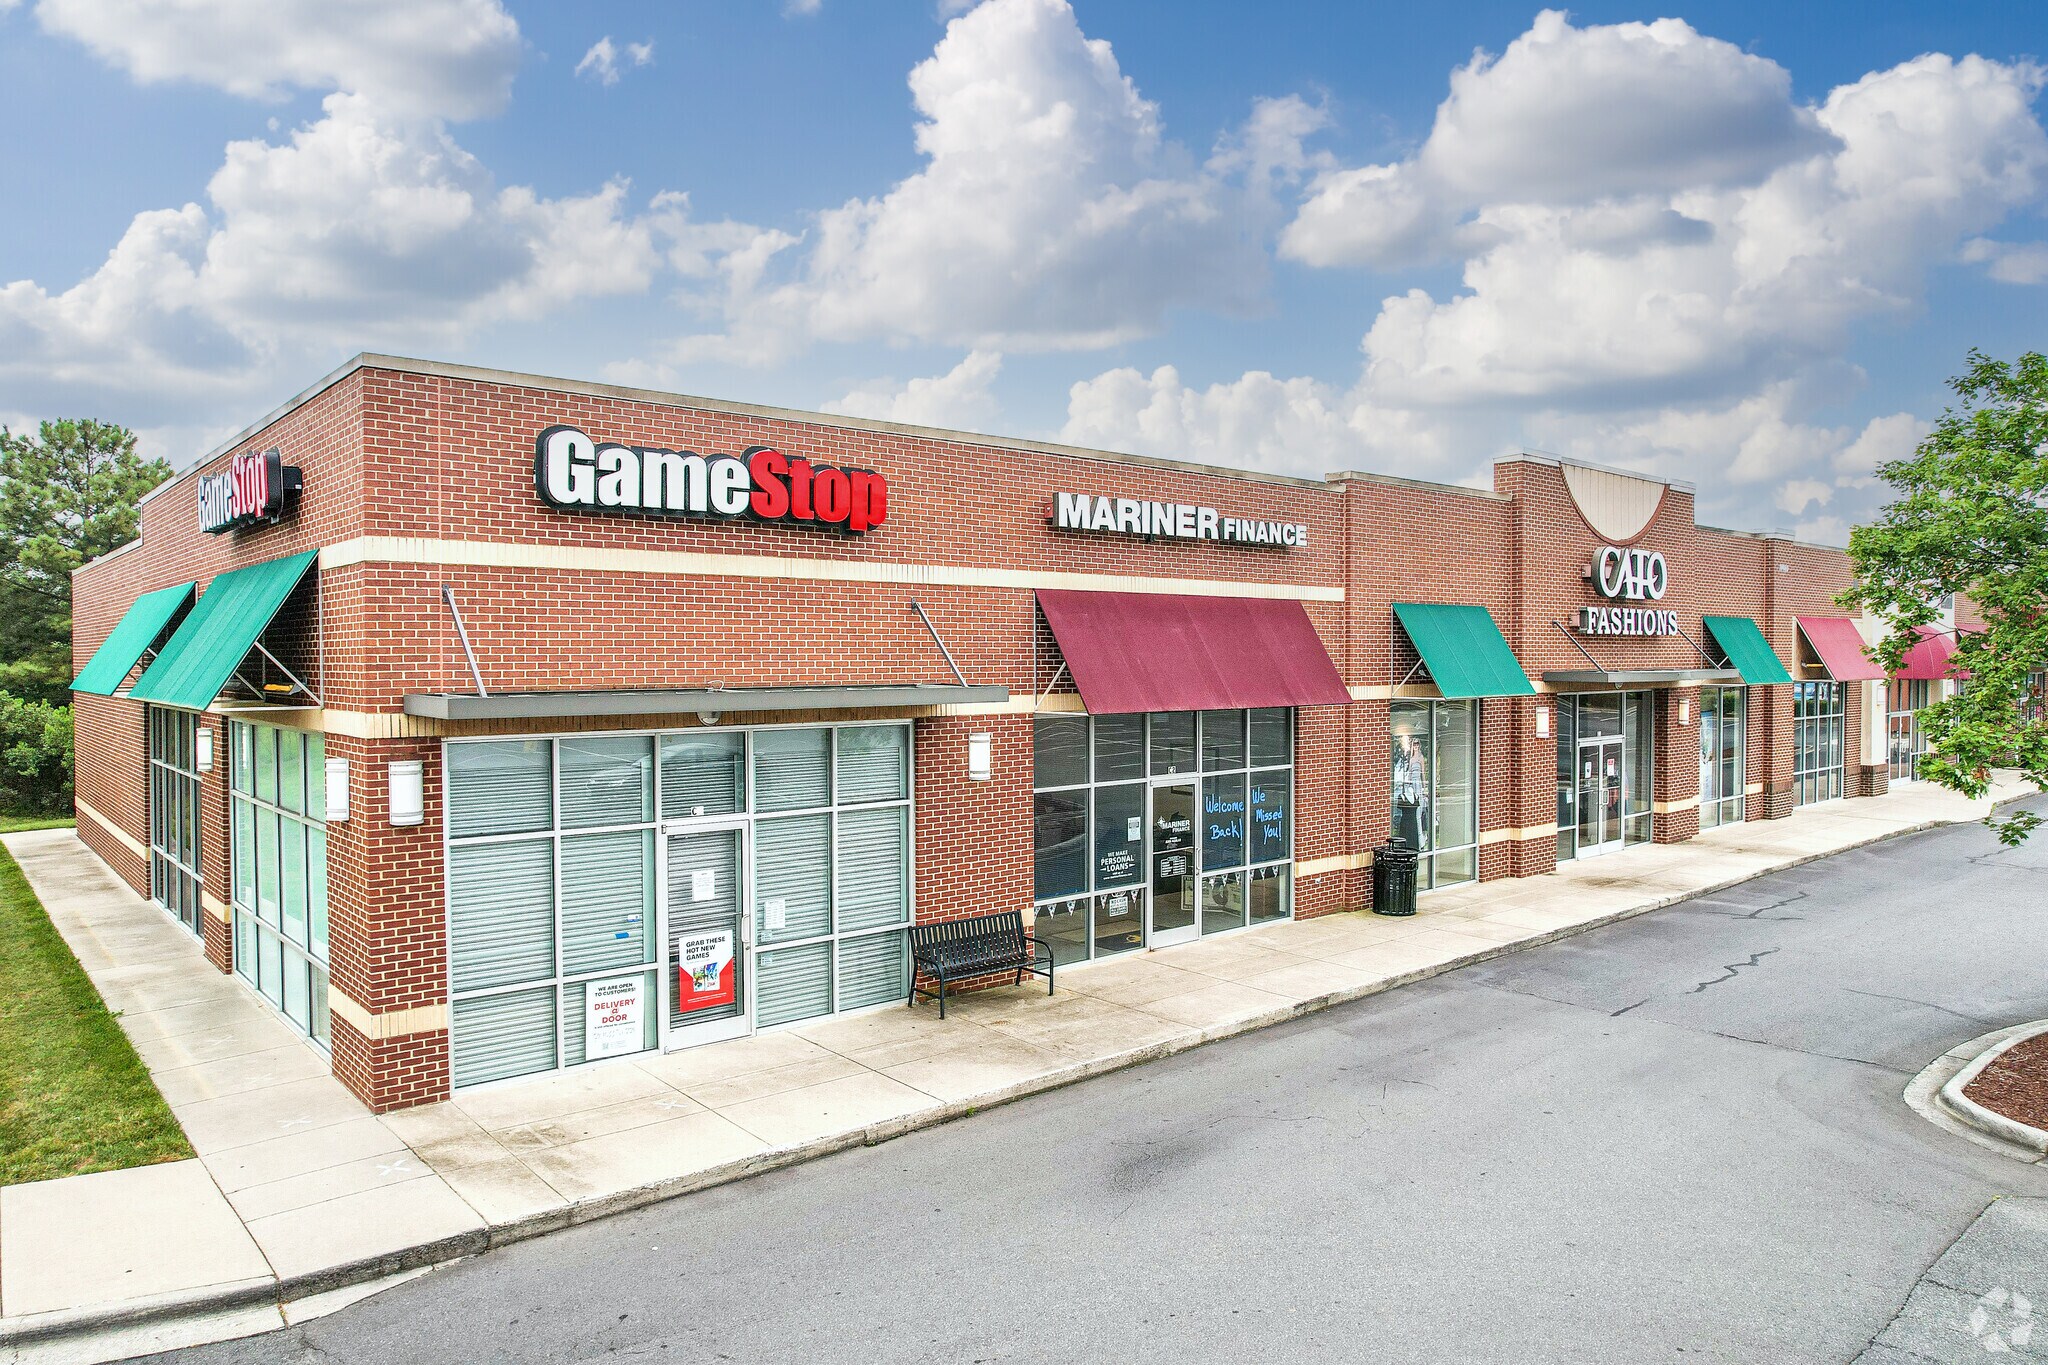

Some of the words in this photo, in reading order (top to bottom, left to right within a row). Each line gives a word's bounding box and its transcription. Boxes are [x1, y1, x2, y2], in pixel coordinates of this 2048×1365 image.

[547, 430, 888, 532] GameStop
[198, 451, 268, 533] GameStop
[1057, 492, 1219, 540] MARINER
[1223, 517, 1308, 547] FINANCE
[1599, 546, 1668, 601] CATO
[1586, 606, 1679, 637] FASHIONS
[1205, 794, 1244, 813] Welcome
[1252, 786, 1265, 804] We
[1256, 805, 1282, 822] Missed
[1162, 820, 1190, 829] MARINER
[1210, 818, 1243, 846] Back!
[1264, 821, 1282, 845] You!
[1101, 855, 1134, 866] PERSONAL
[1106, 862, 1129, 872] LOANS
[686, 939, 705, 948] GRAB
[706, 936, 726, 945] THESE
[686, 952, 710, 961] GAMES
[594, 998, 636, 1010] DELIVERY
[602, 1013, 628, 1024] DOOR
